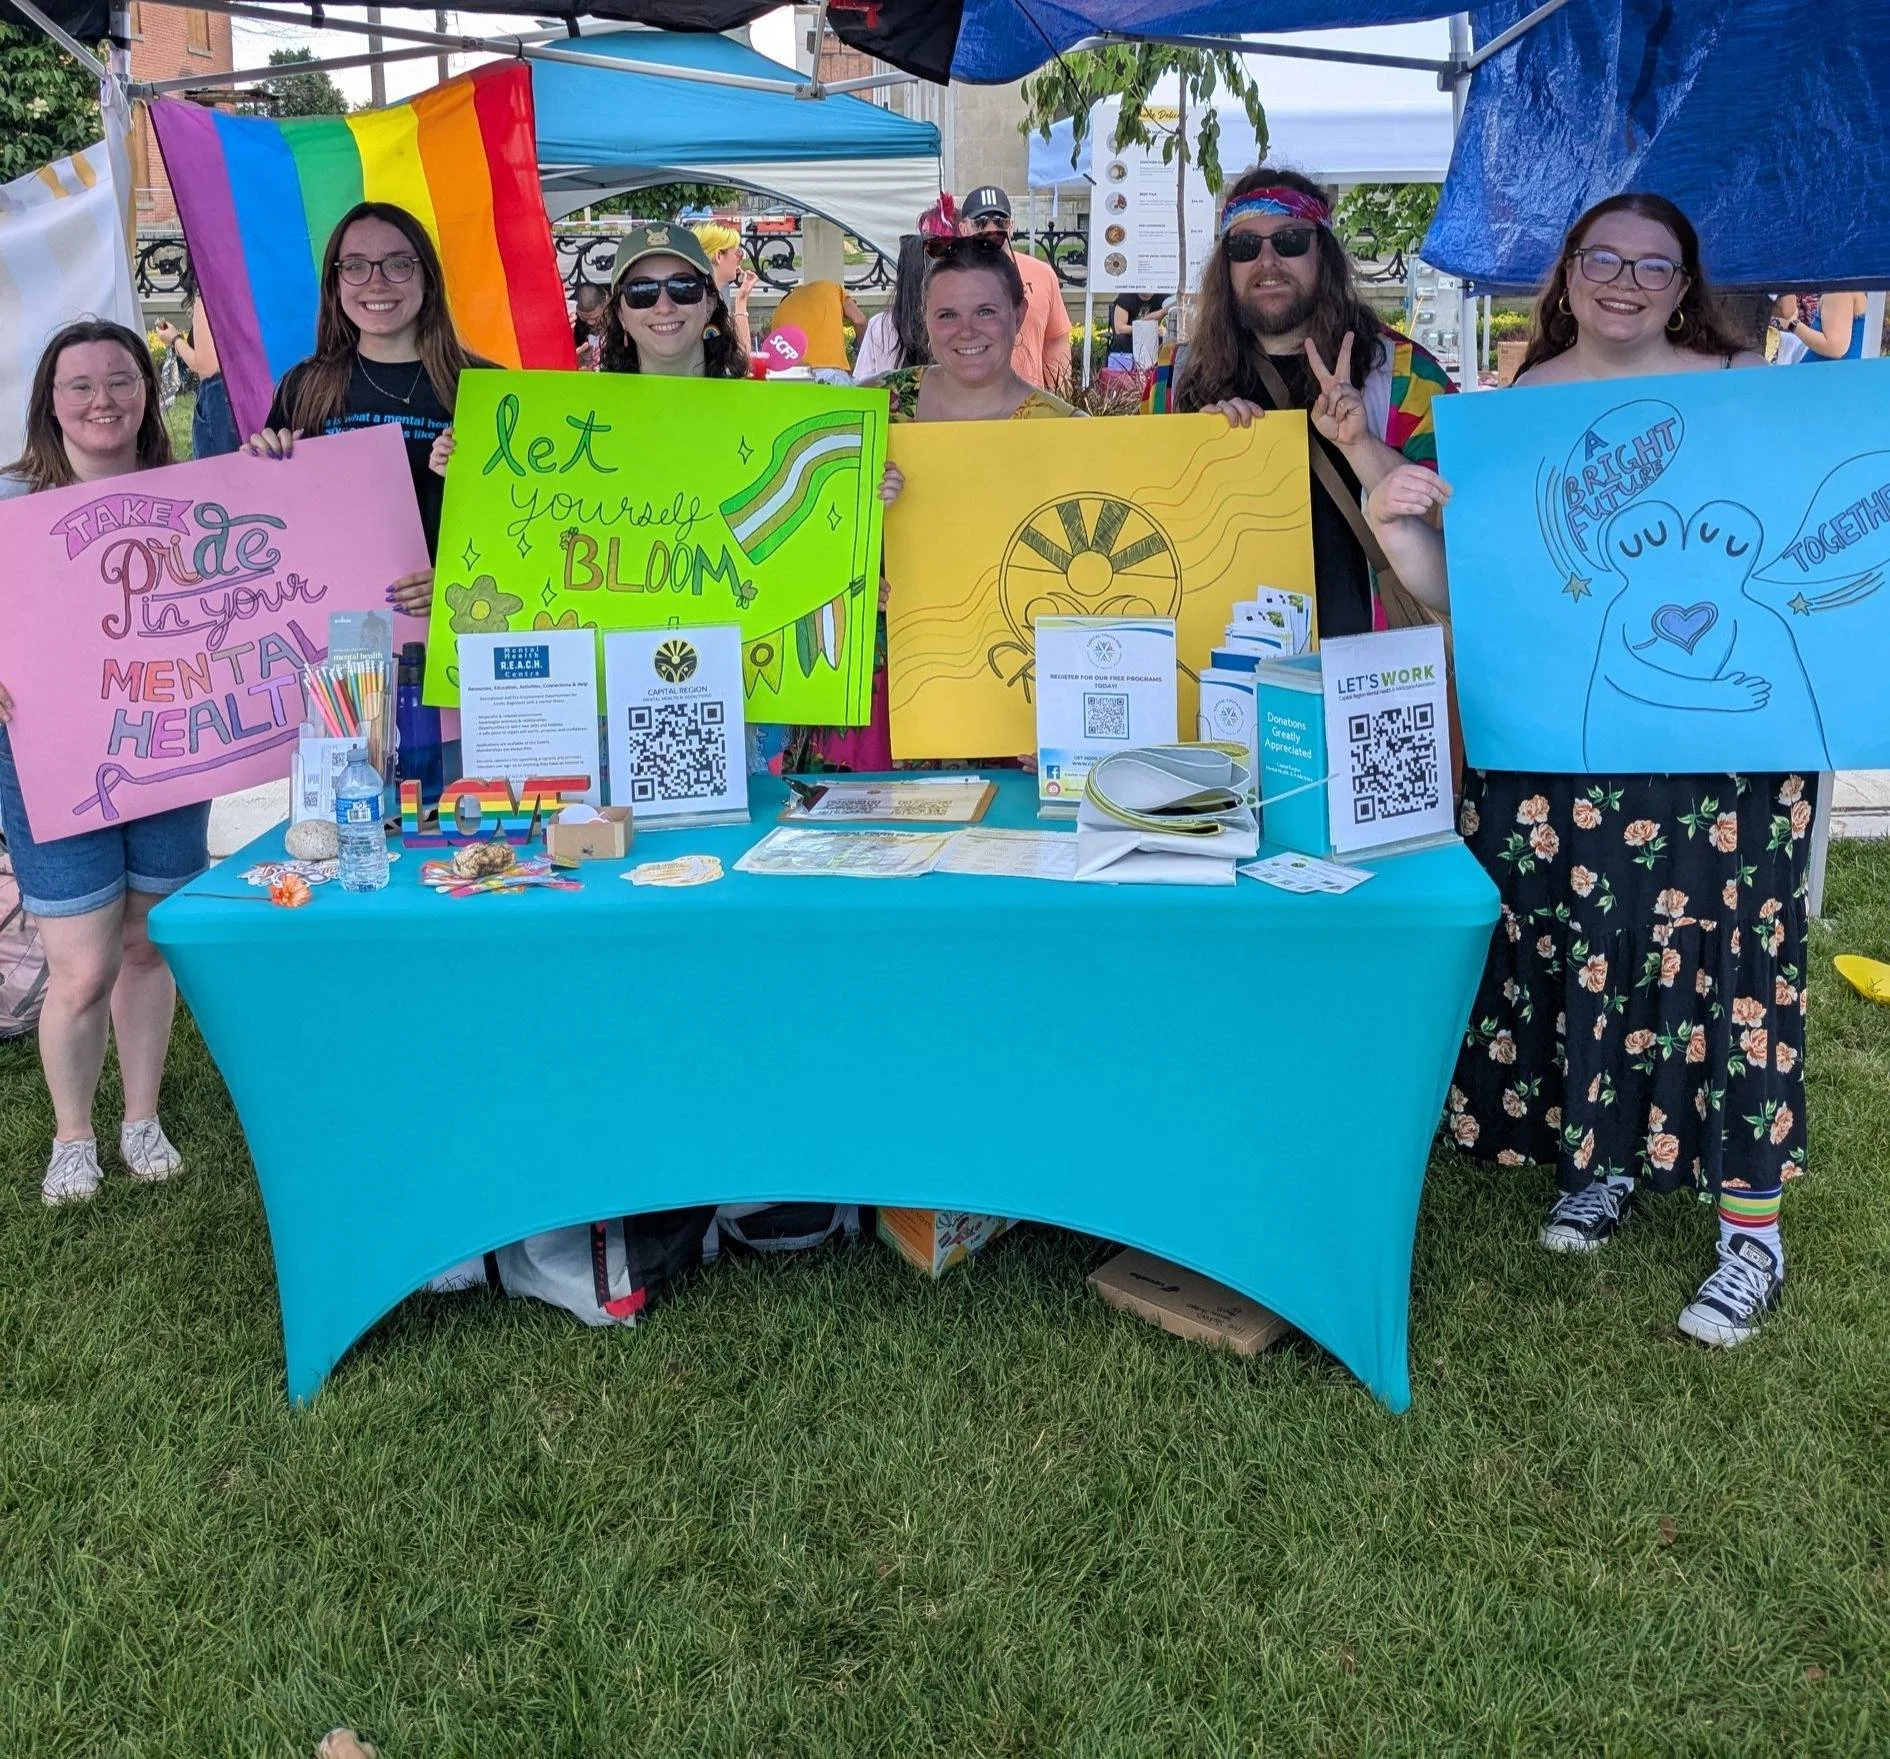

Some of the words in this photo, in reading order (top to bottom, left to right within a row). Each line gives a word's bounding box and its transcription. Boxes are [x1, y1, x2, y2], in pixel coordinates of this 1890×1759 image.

[770, 335, 798, 360] SCFP
[345, 412, 370, 422] what
[373, 414, 380, 422] a
[384, 414, 424, 426] mental
[414, 430, 435, 440] like
[483, 394, 618, 476] let
[1566, 417, 1676, 509] BRIGHT
[1585, 430, 1609, 462] A
[65, 499, 173, 543] TAKE
[507, 484, 713, 541] yourself
[1568, 458, 1664, 552] FUTURE
[100, 502, 287, 640] Pride
[564, 533, 743, 597] BLOOM
[142, 596, 190, 630] in
[200, 573, 328, 651] your
[101, 620, 328, 702] MENTAL
[501, 660, 542, 670] R.E.A.C.H.
[1338, 674, 1379, 694] LET'S
[1381, 664, 1435, 687] WORK
[648, 688, 677, 696] CAPITAL
[680, 685, 708, 694] REGION
[108, 671, 308, 758] HEALT
[1268, 712, 1306, 731] Donations
[1265, 738, 1312, 759] Appreciated
[1272, 726, 1300, 744] Greatly
